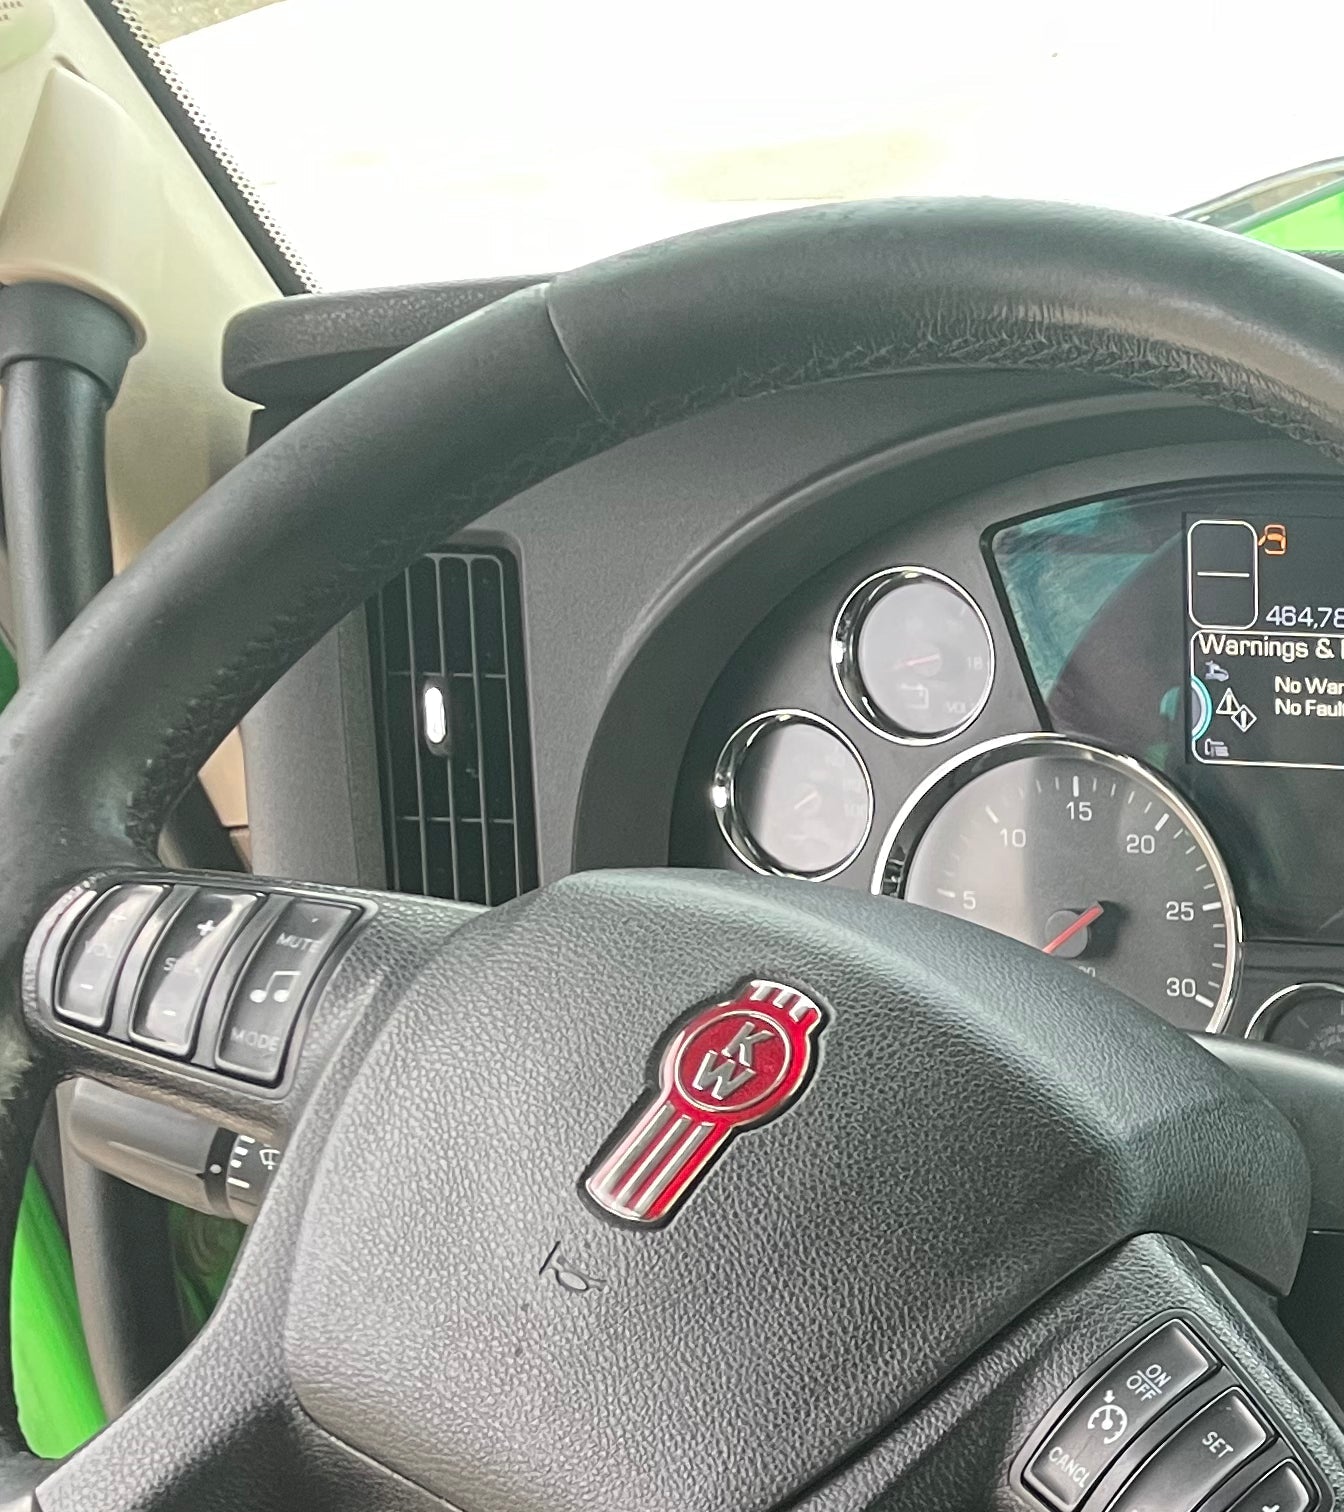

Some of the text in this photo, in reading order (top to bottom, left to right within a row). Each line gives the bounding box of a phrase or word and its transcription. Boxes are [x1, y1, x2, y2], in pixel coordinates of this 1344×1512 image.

[1199, 634, 1308, 663] Warnings
[1315, 639, 1335, 659] &
[1275, 676, 1301, 694] No
[1275, 699, 1301, 716] No
[1066, 801, 1093, 822] 15
[1000, 828, 1027, 848] 10
[1126, 834, 1155, 854] 20
[962, 891, 977, 911] 5
[1166, 902, 1194, 921] 25
[1166, 978, 1196, 998] 30
[231, 1027, 280, 1052] MODE
[1145, 1363, 1172, 1388] ON
[1126, 1374, 1157, 1402] OFF
[1201, 1431, 1234, 1459] SET
[1048, 1446, 1090, 1488] CANCL
